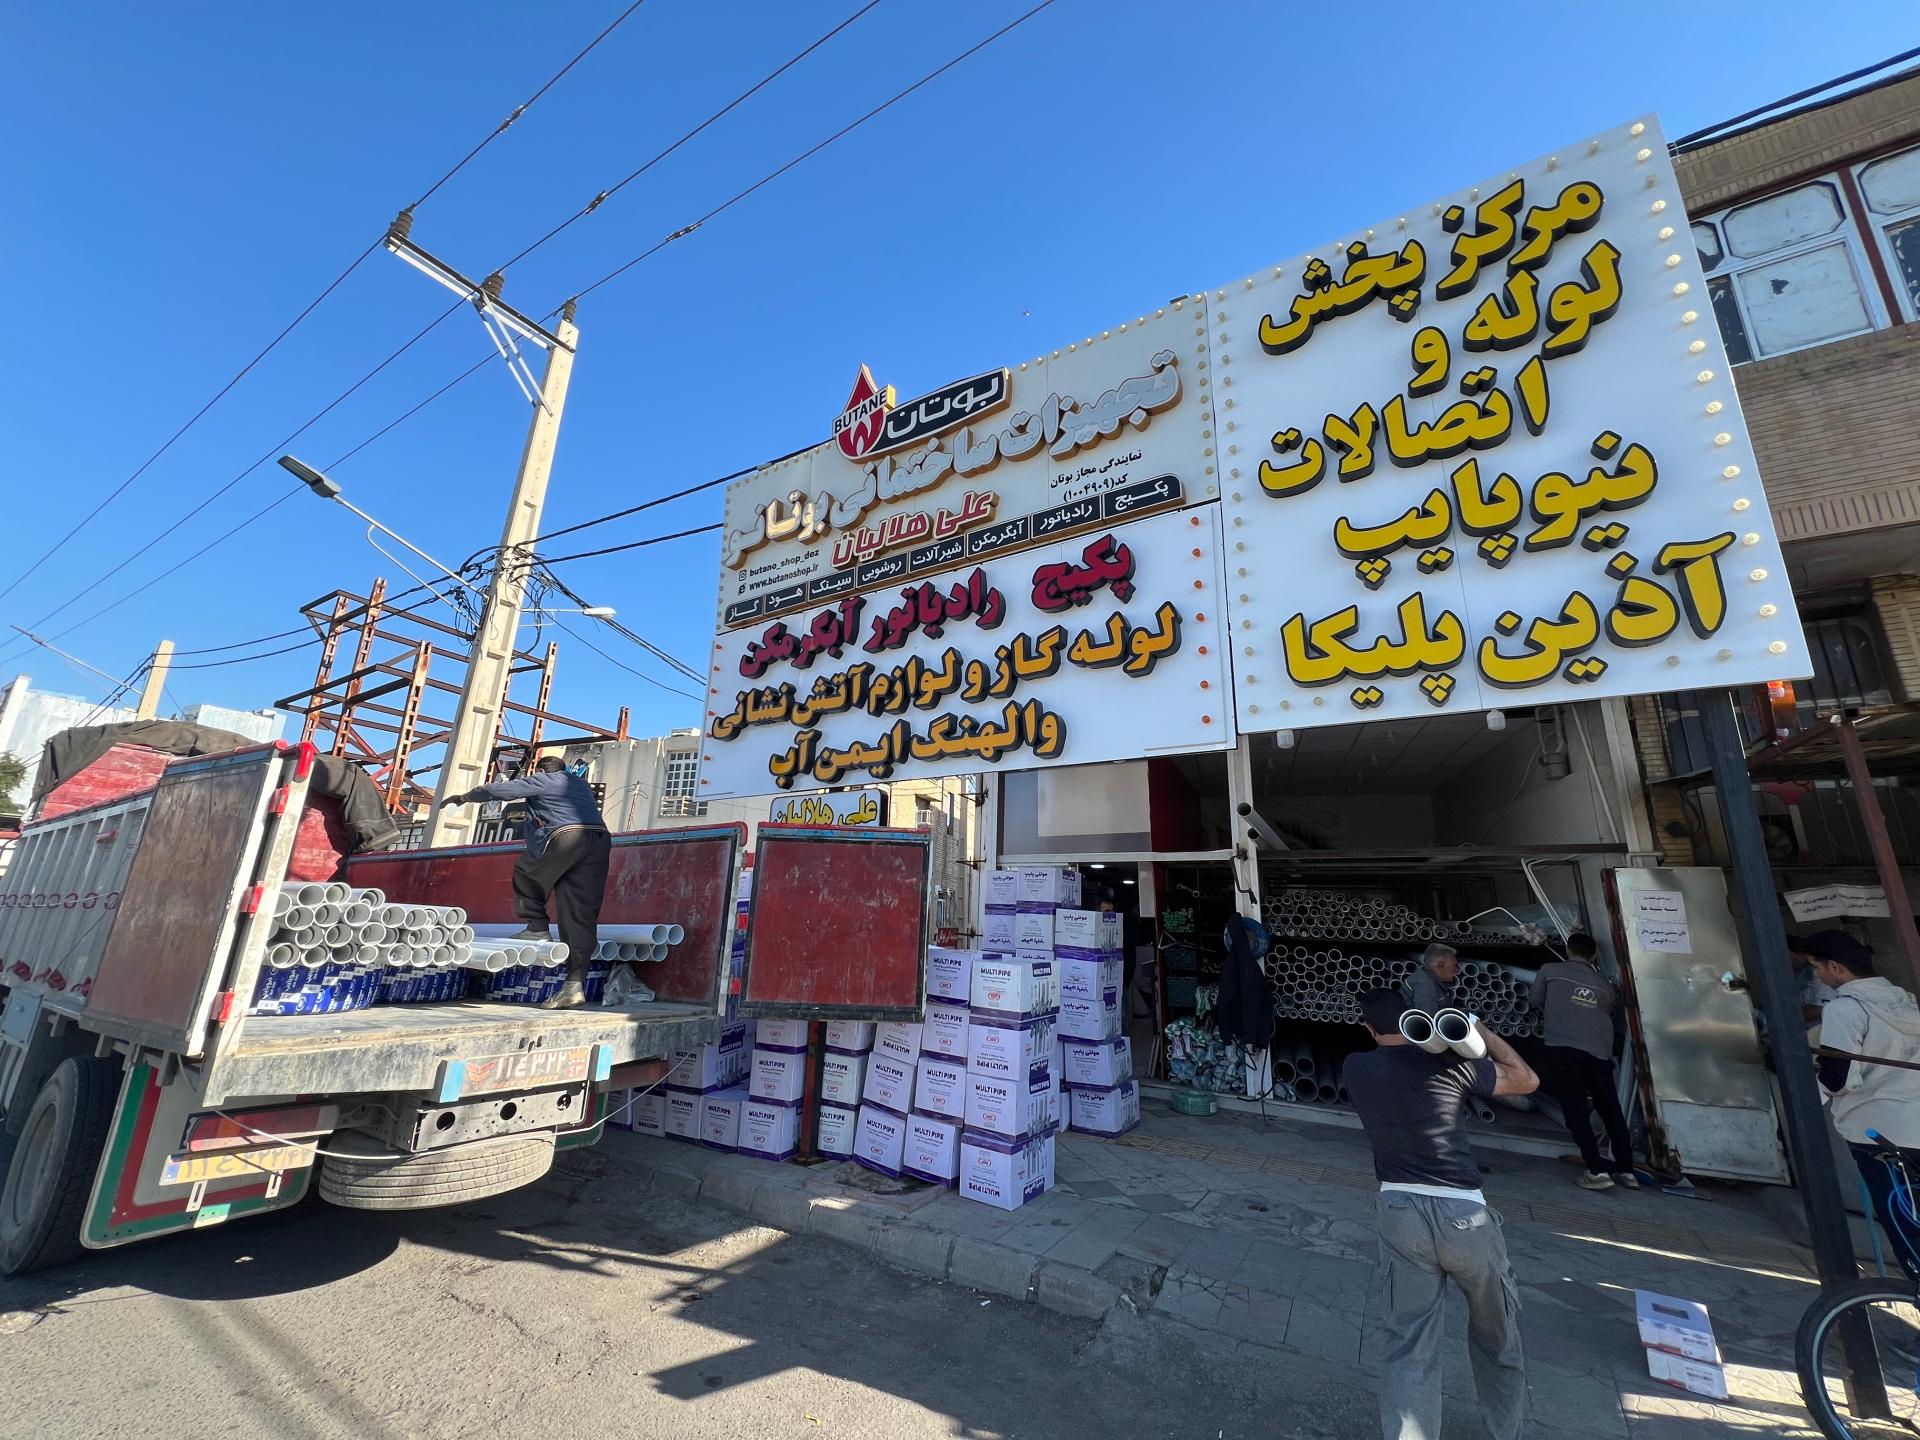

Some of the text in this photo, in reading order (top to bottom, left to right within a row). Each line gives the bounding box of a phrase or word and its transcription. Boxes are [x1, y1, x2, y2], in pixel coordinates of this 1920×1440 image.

[1258, 177, 1605, 354] مرکز پخش
[1408, 239, 1623, 398] لوله و
[834, 390, 888, 434] BUTANE
[887, 376, 999, 439] بوتان
[999, 349, 1183, 462] تجهیزات
[1258, 354, 1551, 498] اتصالات
[829, 426, 1000, 531] ساختمانی
[1050, 449, 1142, 489] نمایندگی مجاز بوتان
[1039, 501, 1093, 529] رادیاتور
[1115, 480, 1169, 511] پکیج
[830, 491, 998, 569] علی هلالیان
[971, 520, 1025, 552] آبگرمکن
[749, 549, 820, 577] butano_shop_dez
[749, 563, 819, 591] www.butanoshop.ir
[861, 559, 902, 582] روشویی
[768, 587, 804, 607] هود
[811, 576, 852, 594] سینک
[729, 599, 760, 620] گاز
[739, 533, 1137, 680] پکیج رادیاتور آبگرمکن
[1280, 532, 1737, 709] آذین پلیکا
[711, 600, 1184, 741] لوله گاز و لوازم آتش نشانی
[768, 727, 822, 789] آب
[813, 718, 912, 784] ایمن
[838, 793, 877, 826] علی
[980, 967, 1011, 977] MULTI PIPE
[975, 1084, 1007, 1096] MULTI PIPE
